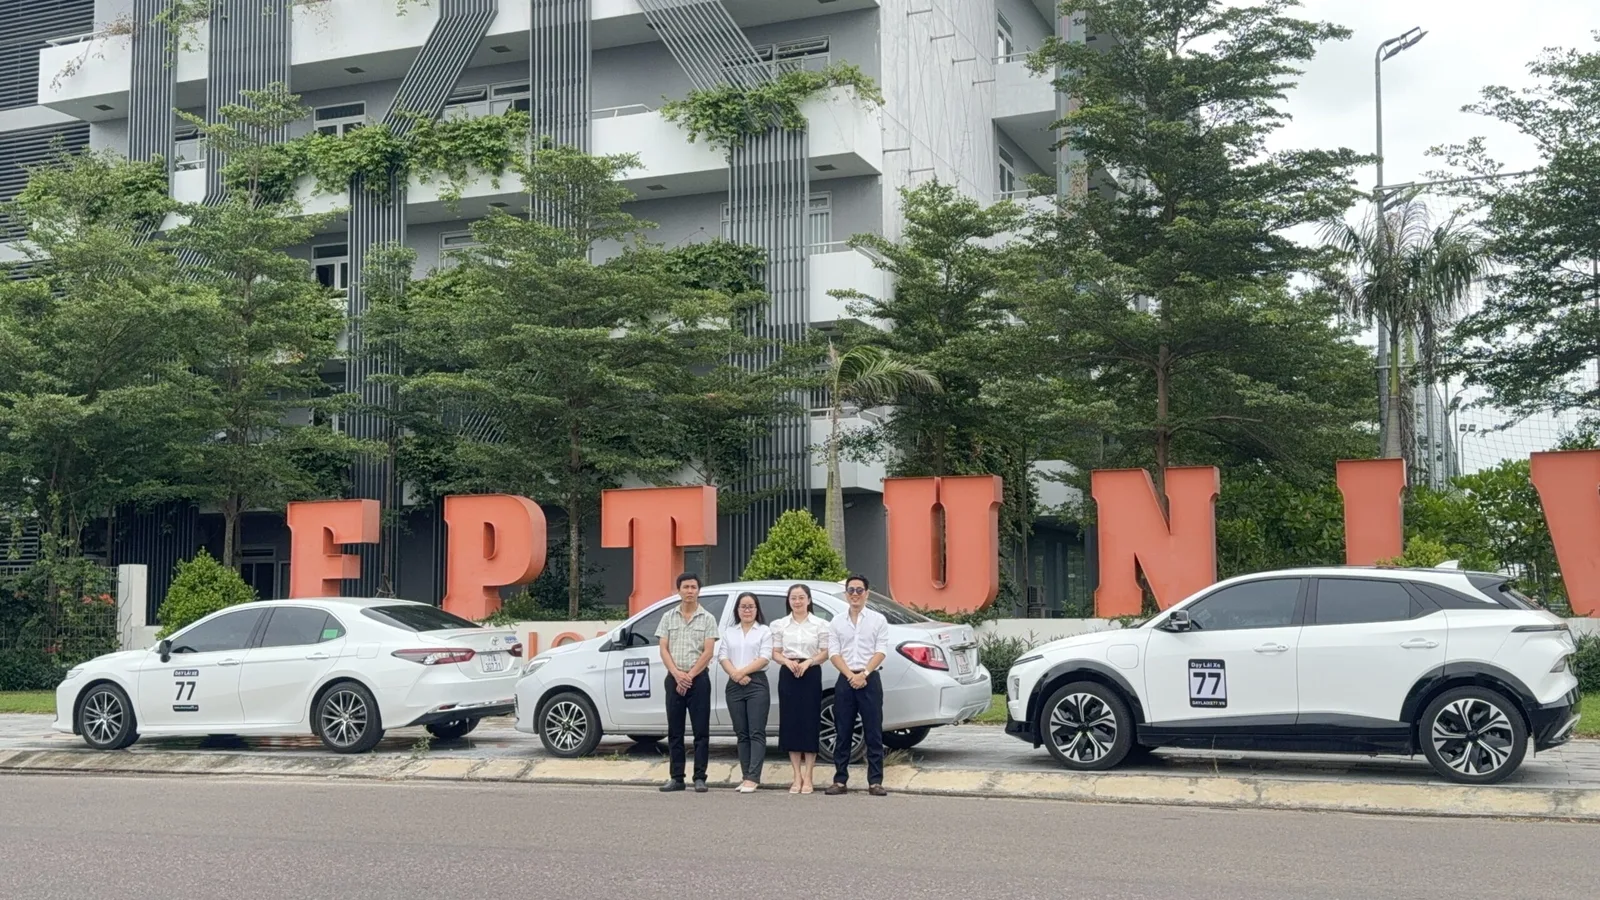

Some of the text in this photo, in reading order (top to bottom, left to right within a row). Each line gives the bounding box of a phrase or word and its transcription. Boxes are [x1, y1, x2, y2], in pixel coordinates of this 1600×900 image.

[626, 668, 647, 689] 77
[1193, 672, 1221, 695] 77
[175, 681, 196, 701] 77
